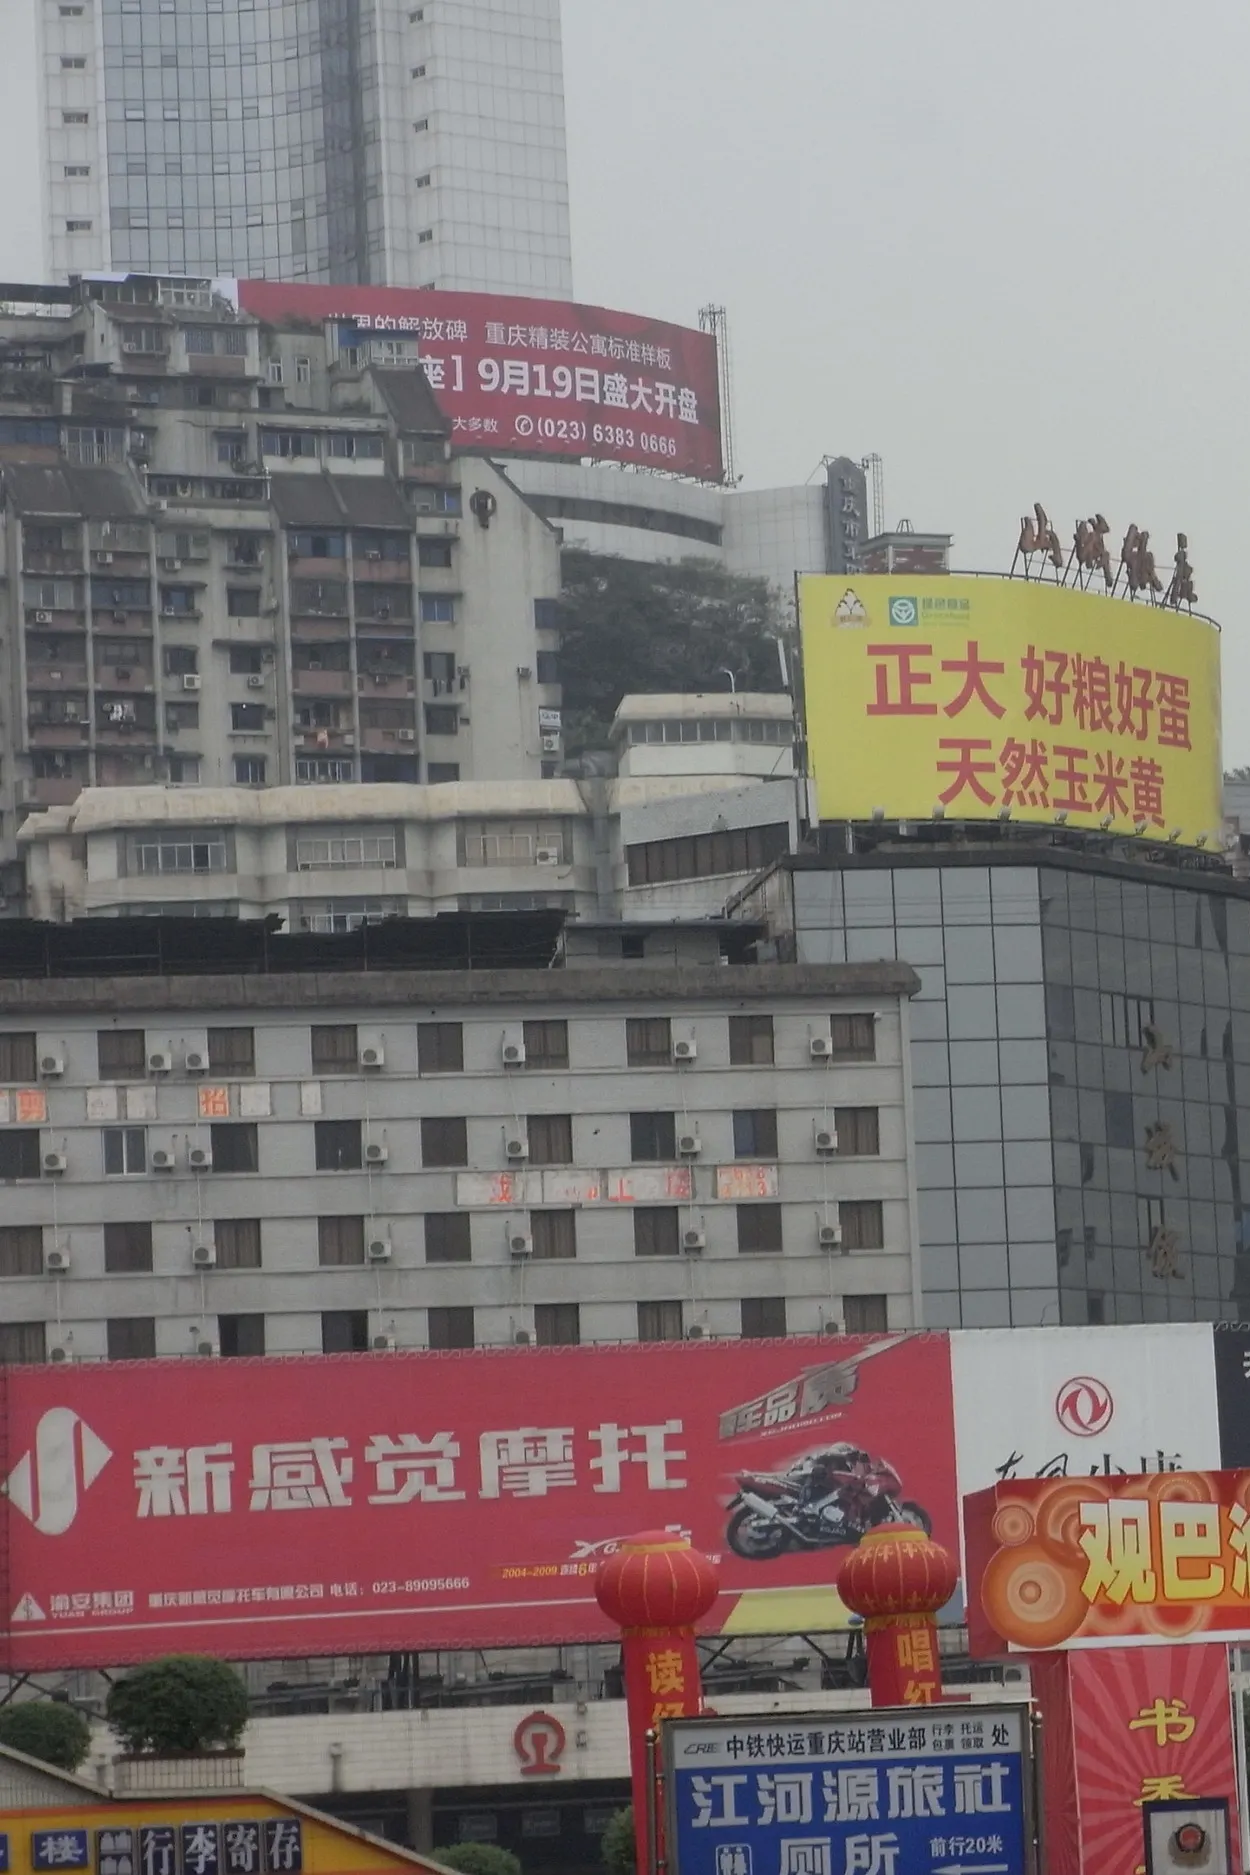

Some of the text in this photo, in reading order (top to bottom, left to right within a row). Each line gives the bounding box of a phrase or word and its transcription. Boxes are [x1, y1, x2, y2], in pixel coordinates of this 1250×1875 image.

[485, 321, 672, 371] 重庆精装公寓标准样板
[866, 640, 1192, 752] 正大 好粮好蛋
[937, 737, 1165, 829] 天然玉米黄
[133, 1419, 688, 1517] 新感觉摩托
[726, 1727, 926, 1759] 中铁快运重庆站营业部
[691, 1762, 1011, 1828] 江河源旅社
[143, 1821, 300, 1875] 行李寄存
[779, 1833, 1003, 1875] 厕所 前行20米
